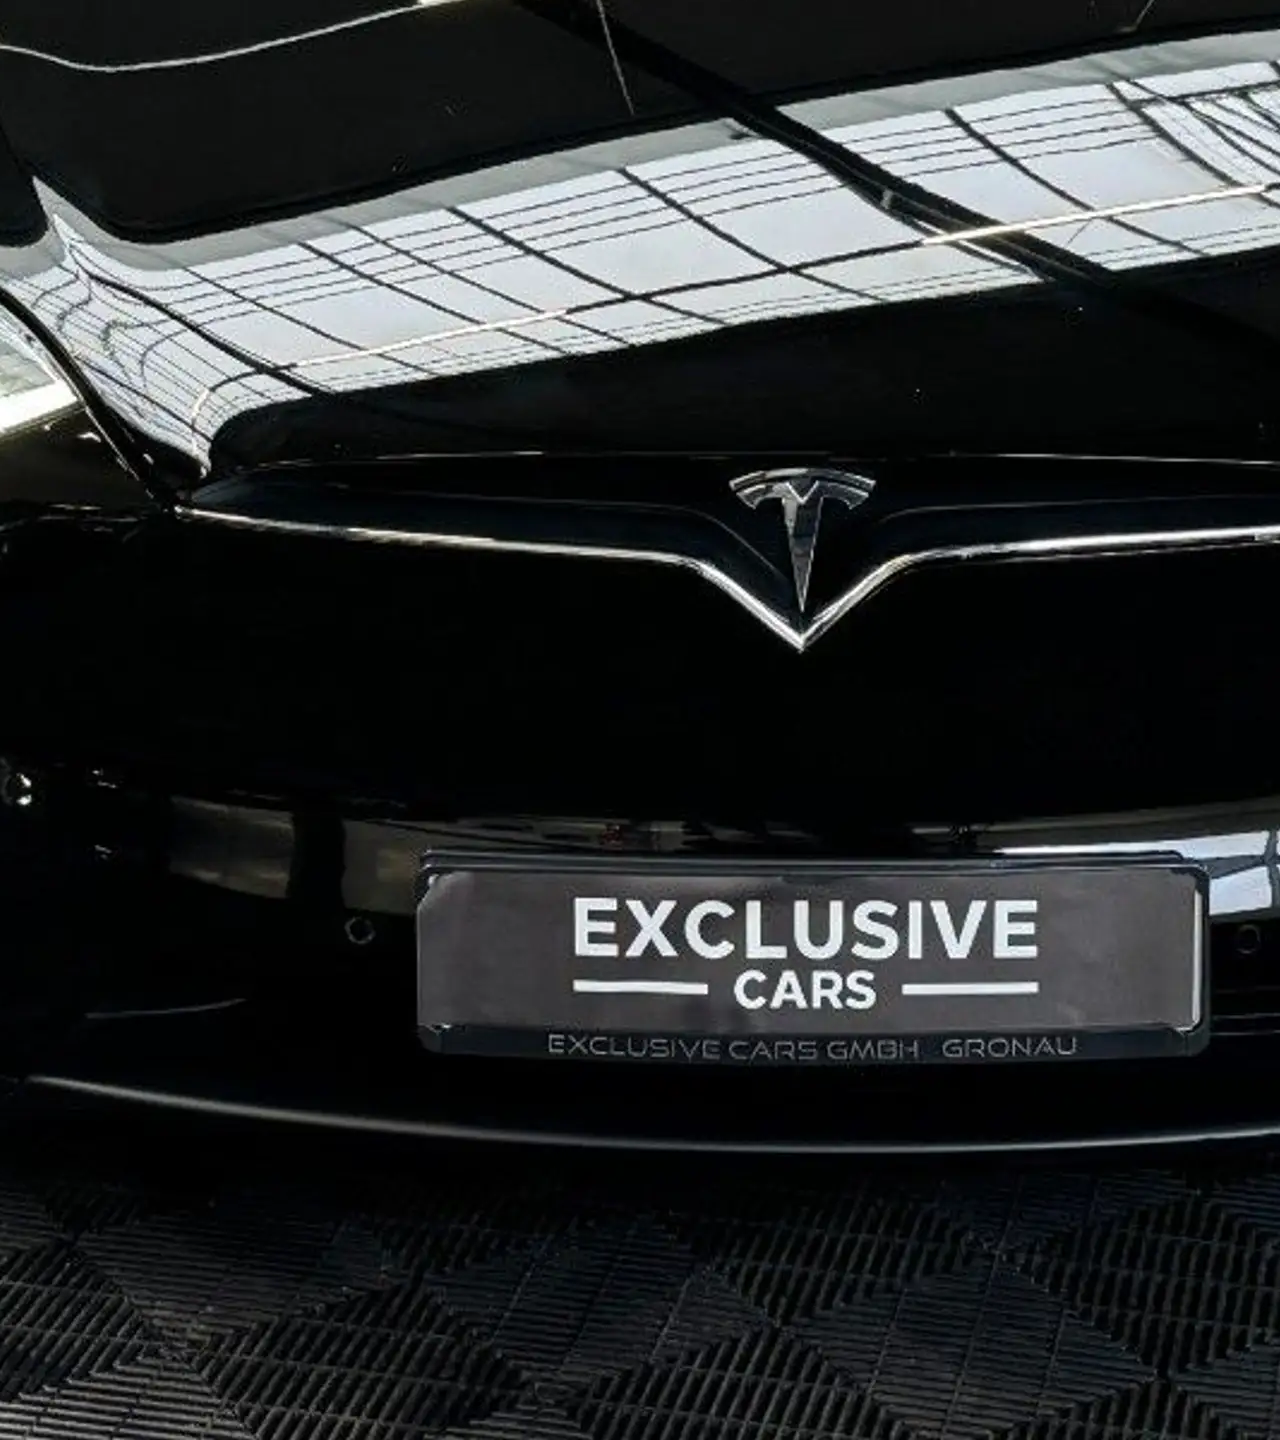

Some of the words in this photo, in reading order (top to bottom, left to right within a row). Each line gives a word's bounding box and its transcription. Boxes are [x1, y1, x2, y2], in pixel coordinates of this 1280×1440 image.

[573, 897, 1039, 959] EXCLUSIVE
[733, 969, 878, 1011] CARS
[547, 1033, 720, 1060] EXCLUSIVE
[728, 1039, 818, 1061] CARS
[826, 1039, 919, 1060] GMBH
[942, 1036, 1078, 1059] GRONAU
